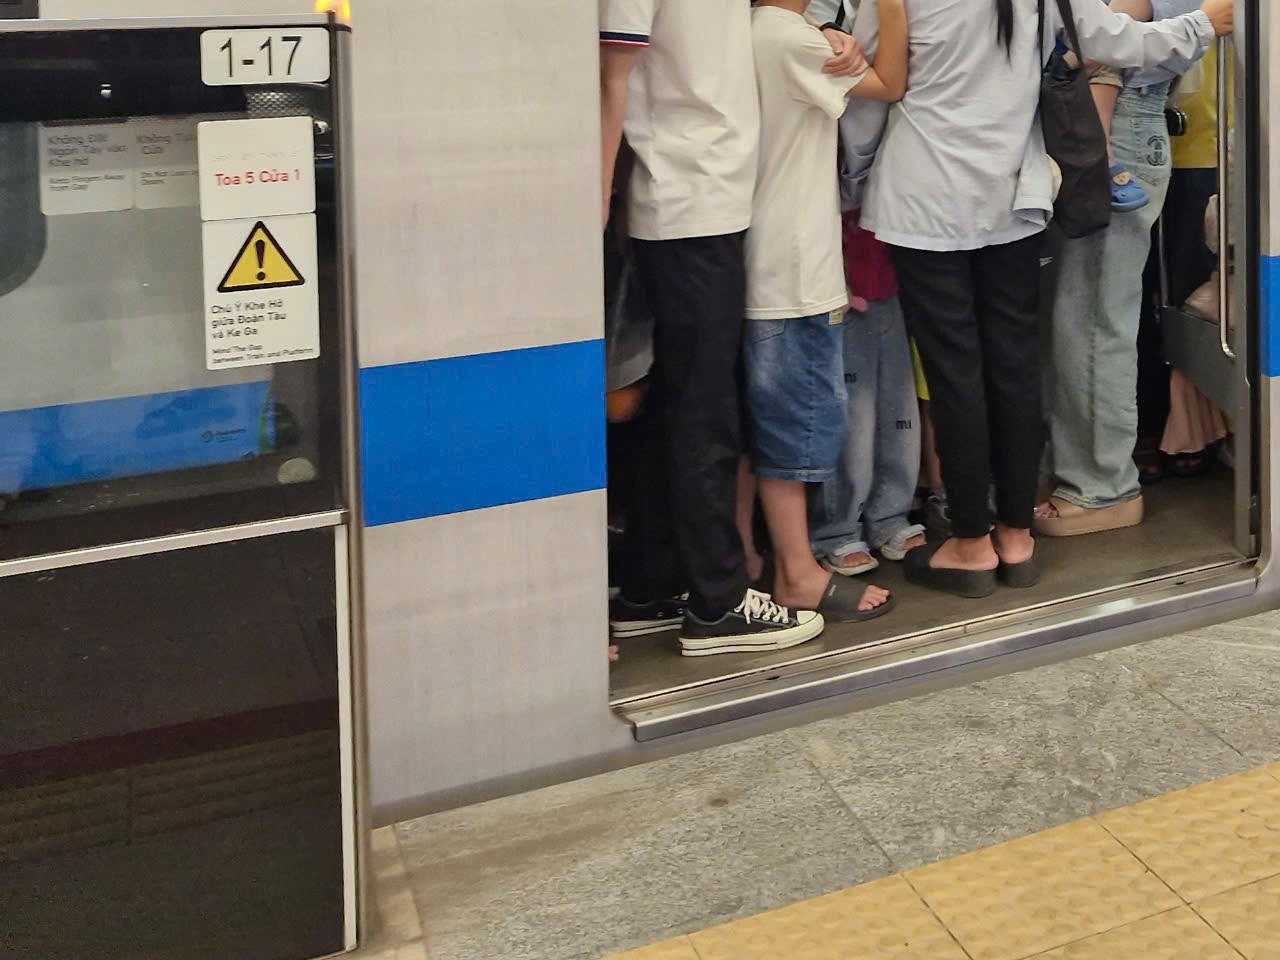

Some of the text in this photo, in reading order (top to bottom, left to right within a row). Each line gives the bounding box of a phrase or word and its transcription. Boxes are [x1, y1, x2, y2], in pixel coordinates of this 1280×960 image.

[220, 36, 302, 78] 1-17
[214, 173, 241, 186] Toa
[246, 171, 255, 184] 5
[259, 168, 289, 183] Cửa
[294, 169, 301, 181] 1
[245, 300, 265, 311] Khe
